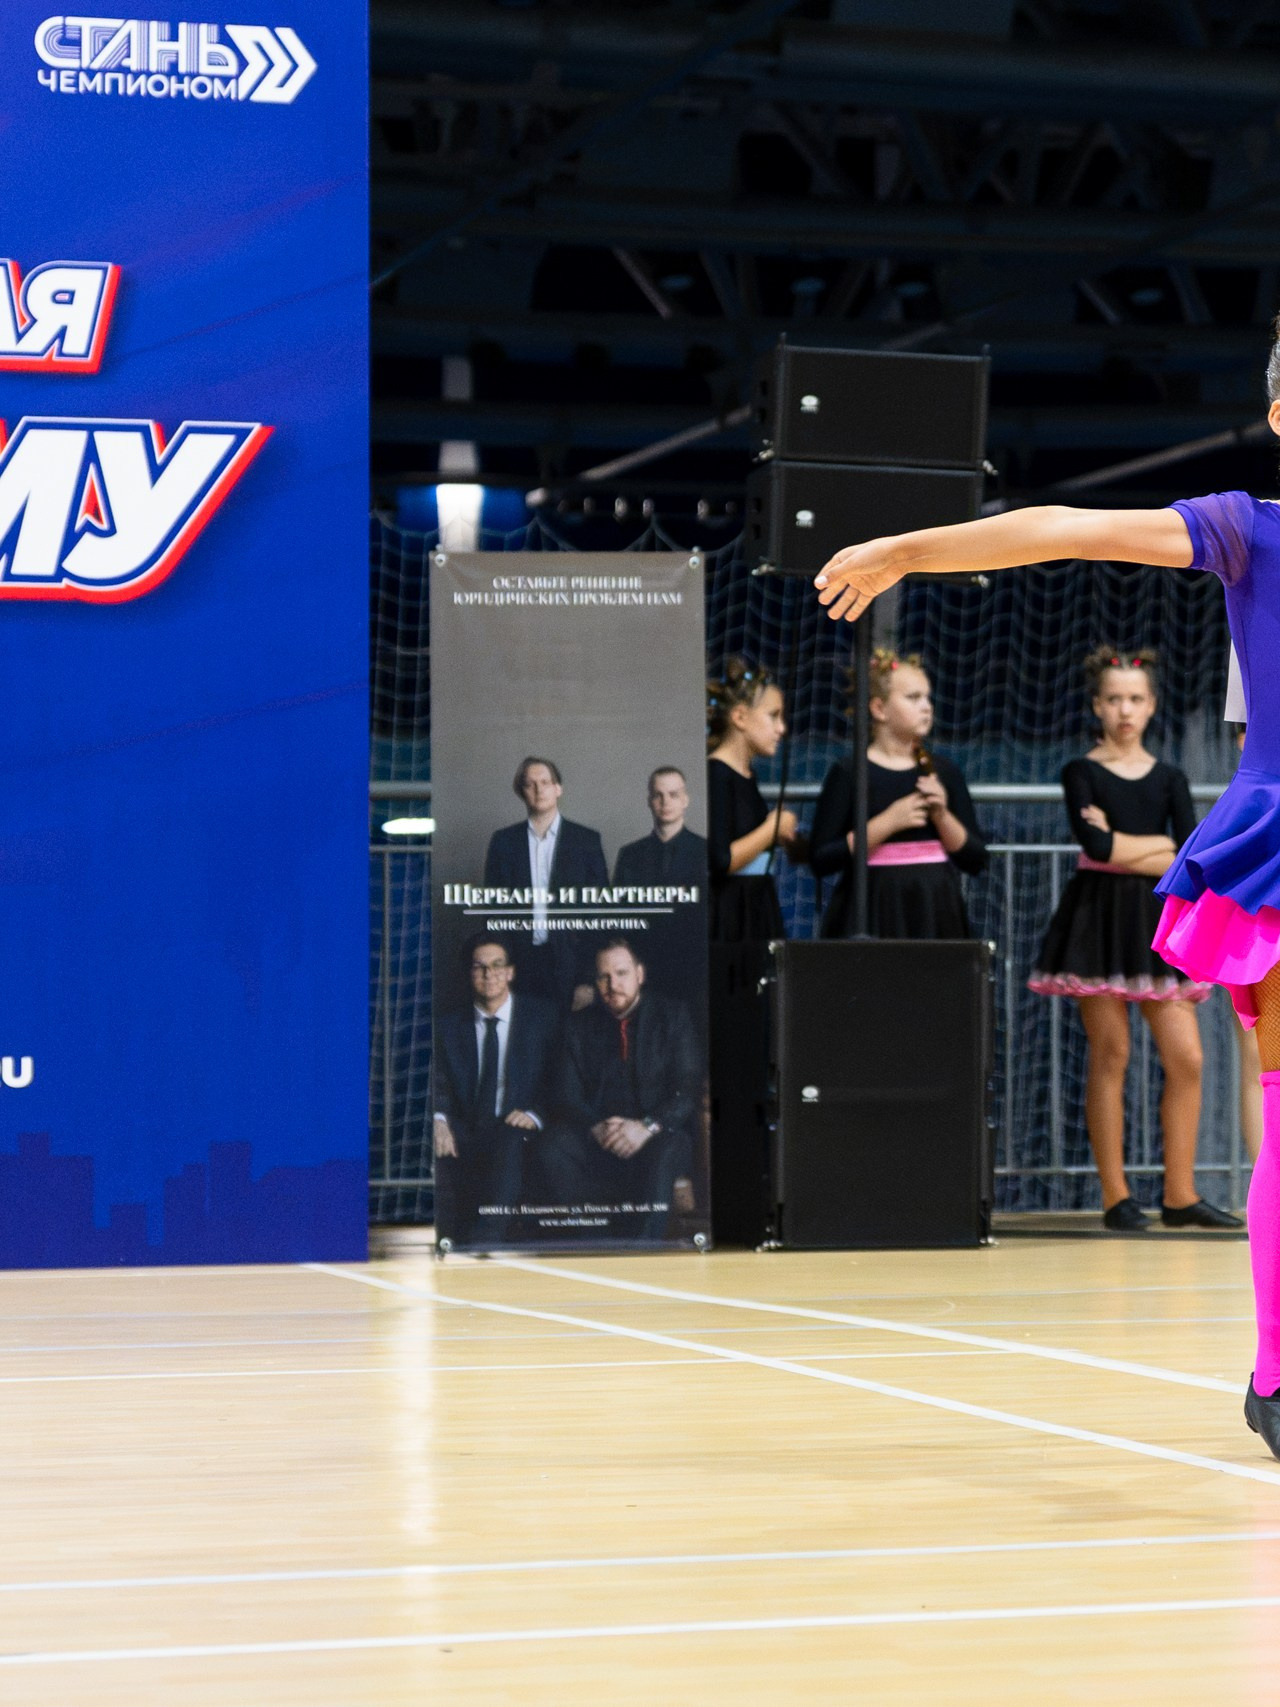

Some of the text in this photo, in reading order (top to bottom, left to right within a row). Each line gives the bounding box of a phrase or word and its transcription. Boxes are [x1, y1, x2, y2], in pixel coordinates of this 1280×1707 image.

[34, 16, 239, 76] СТАНЬ
[37, 69, 239, 100] ЧЕМПИОНОМ
[0, 1056, 34, 1088] U
